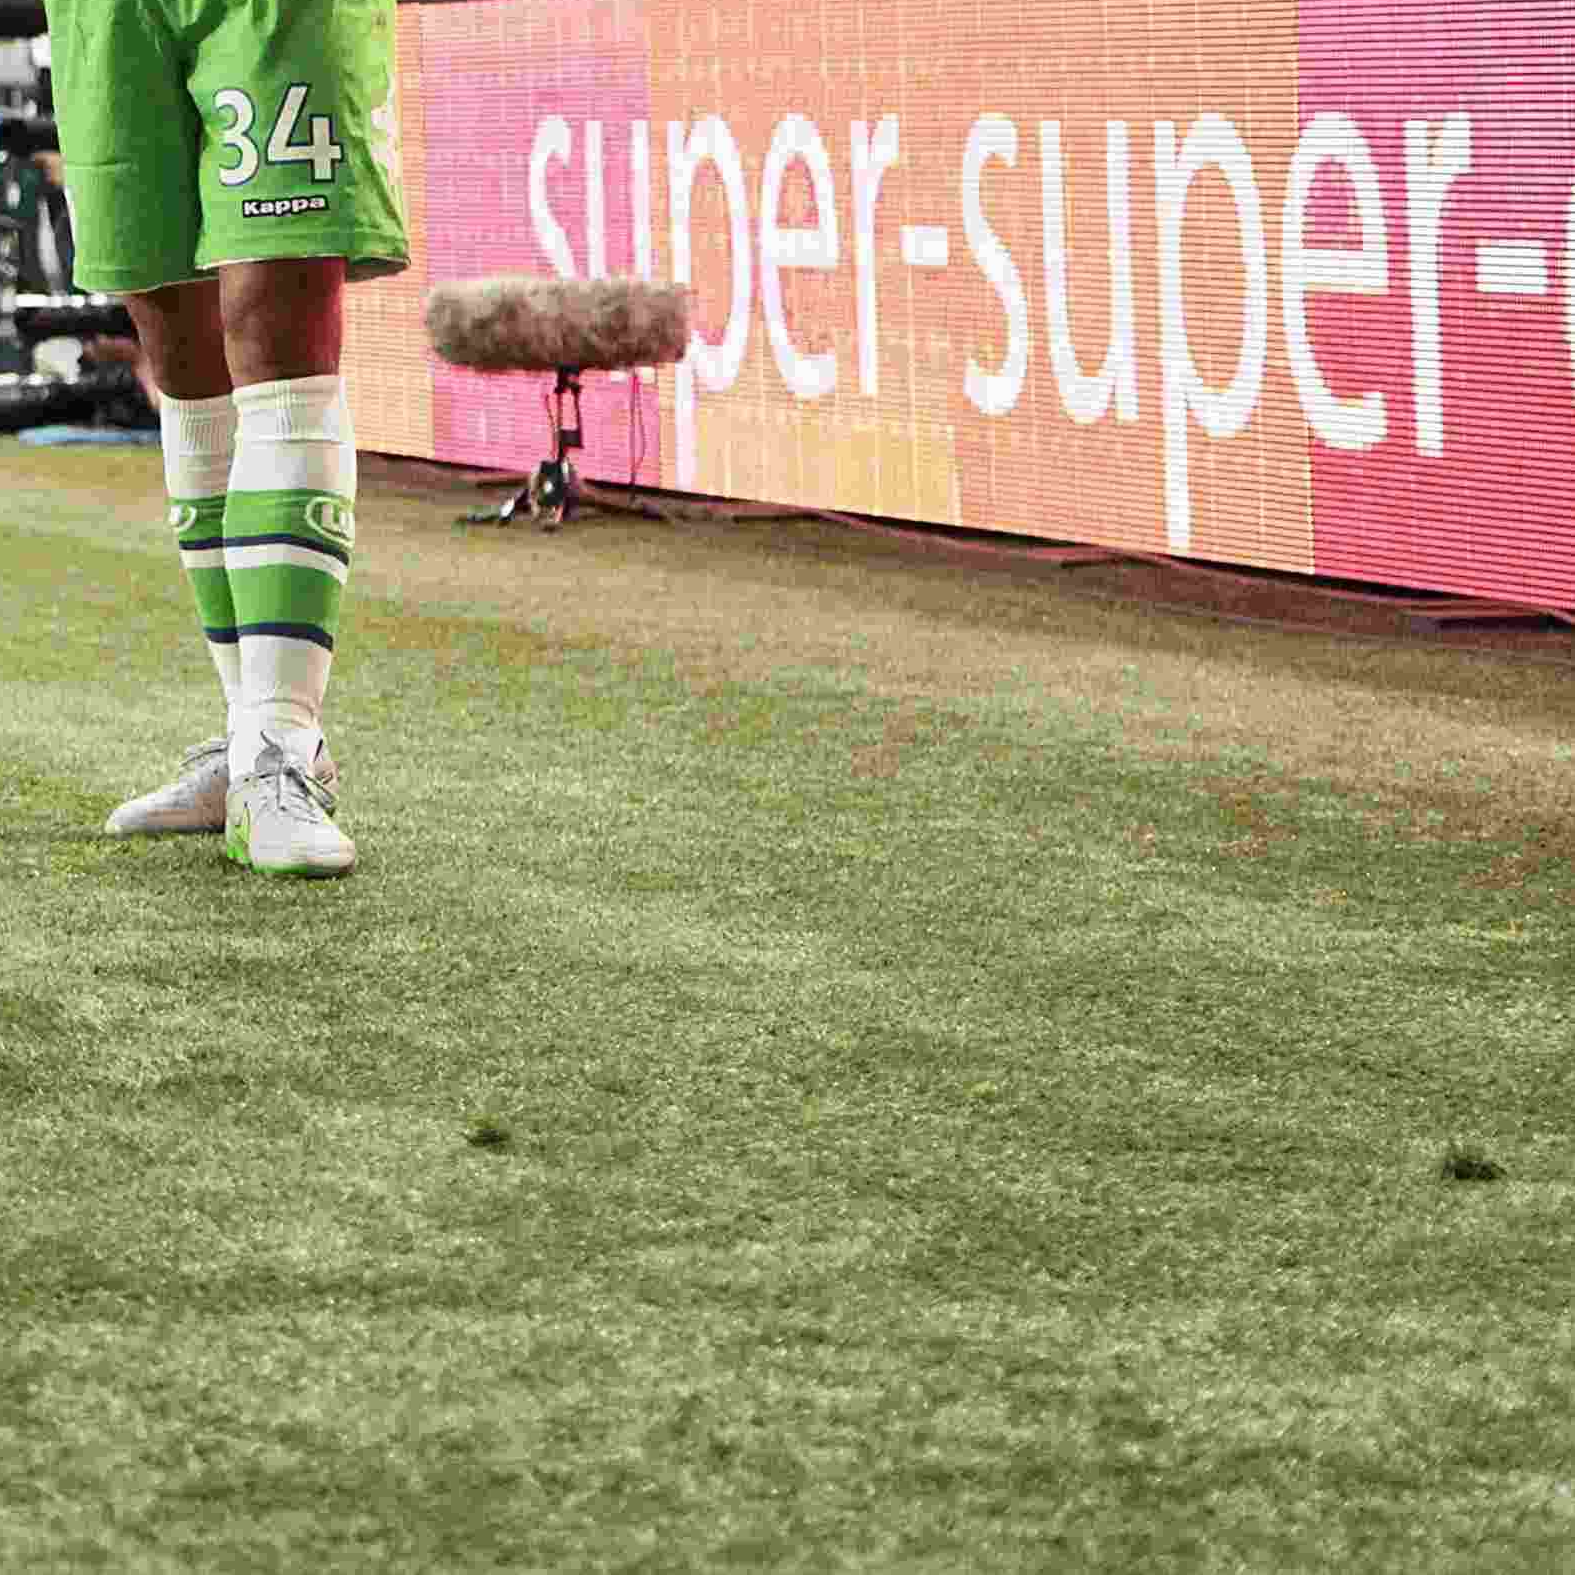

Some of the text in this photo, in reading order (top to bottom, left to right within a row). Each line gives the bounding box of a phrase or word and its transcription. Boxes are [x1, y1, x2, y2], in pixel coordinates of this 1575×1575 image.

[212, 82, 344, 187] 34
[242, 195, 328, 218] Kappa
[528, 111, 1575, 551] super-super-
